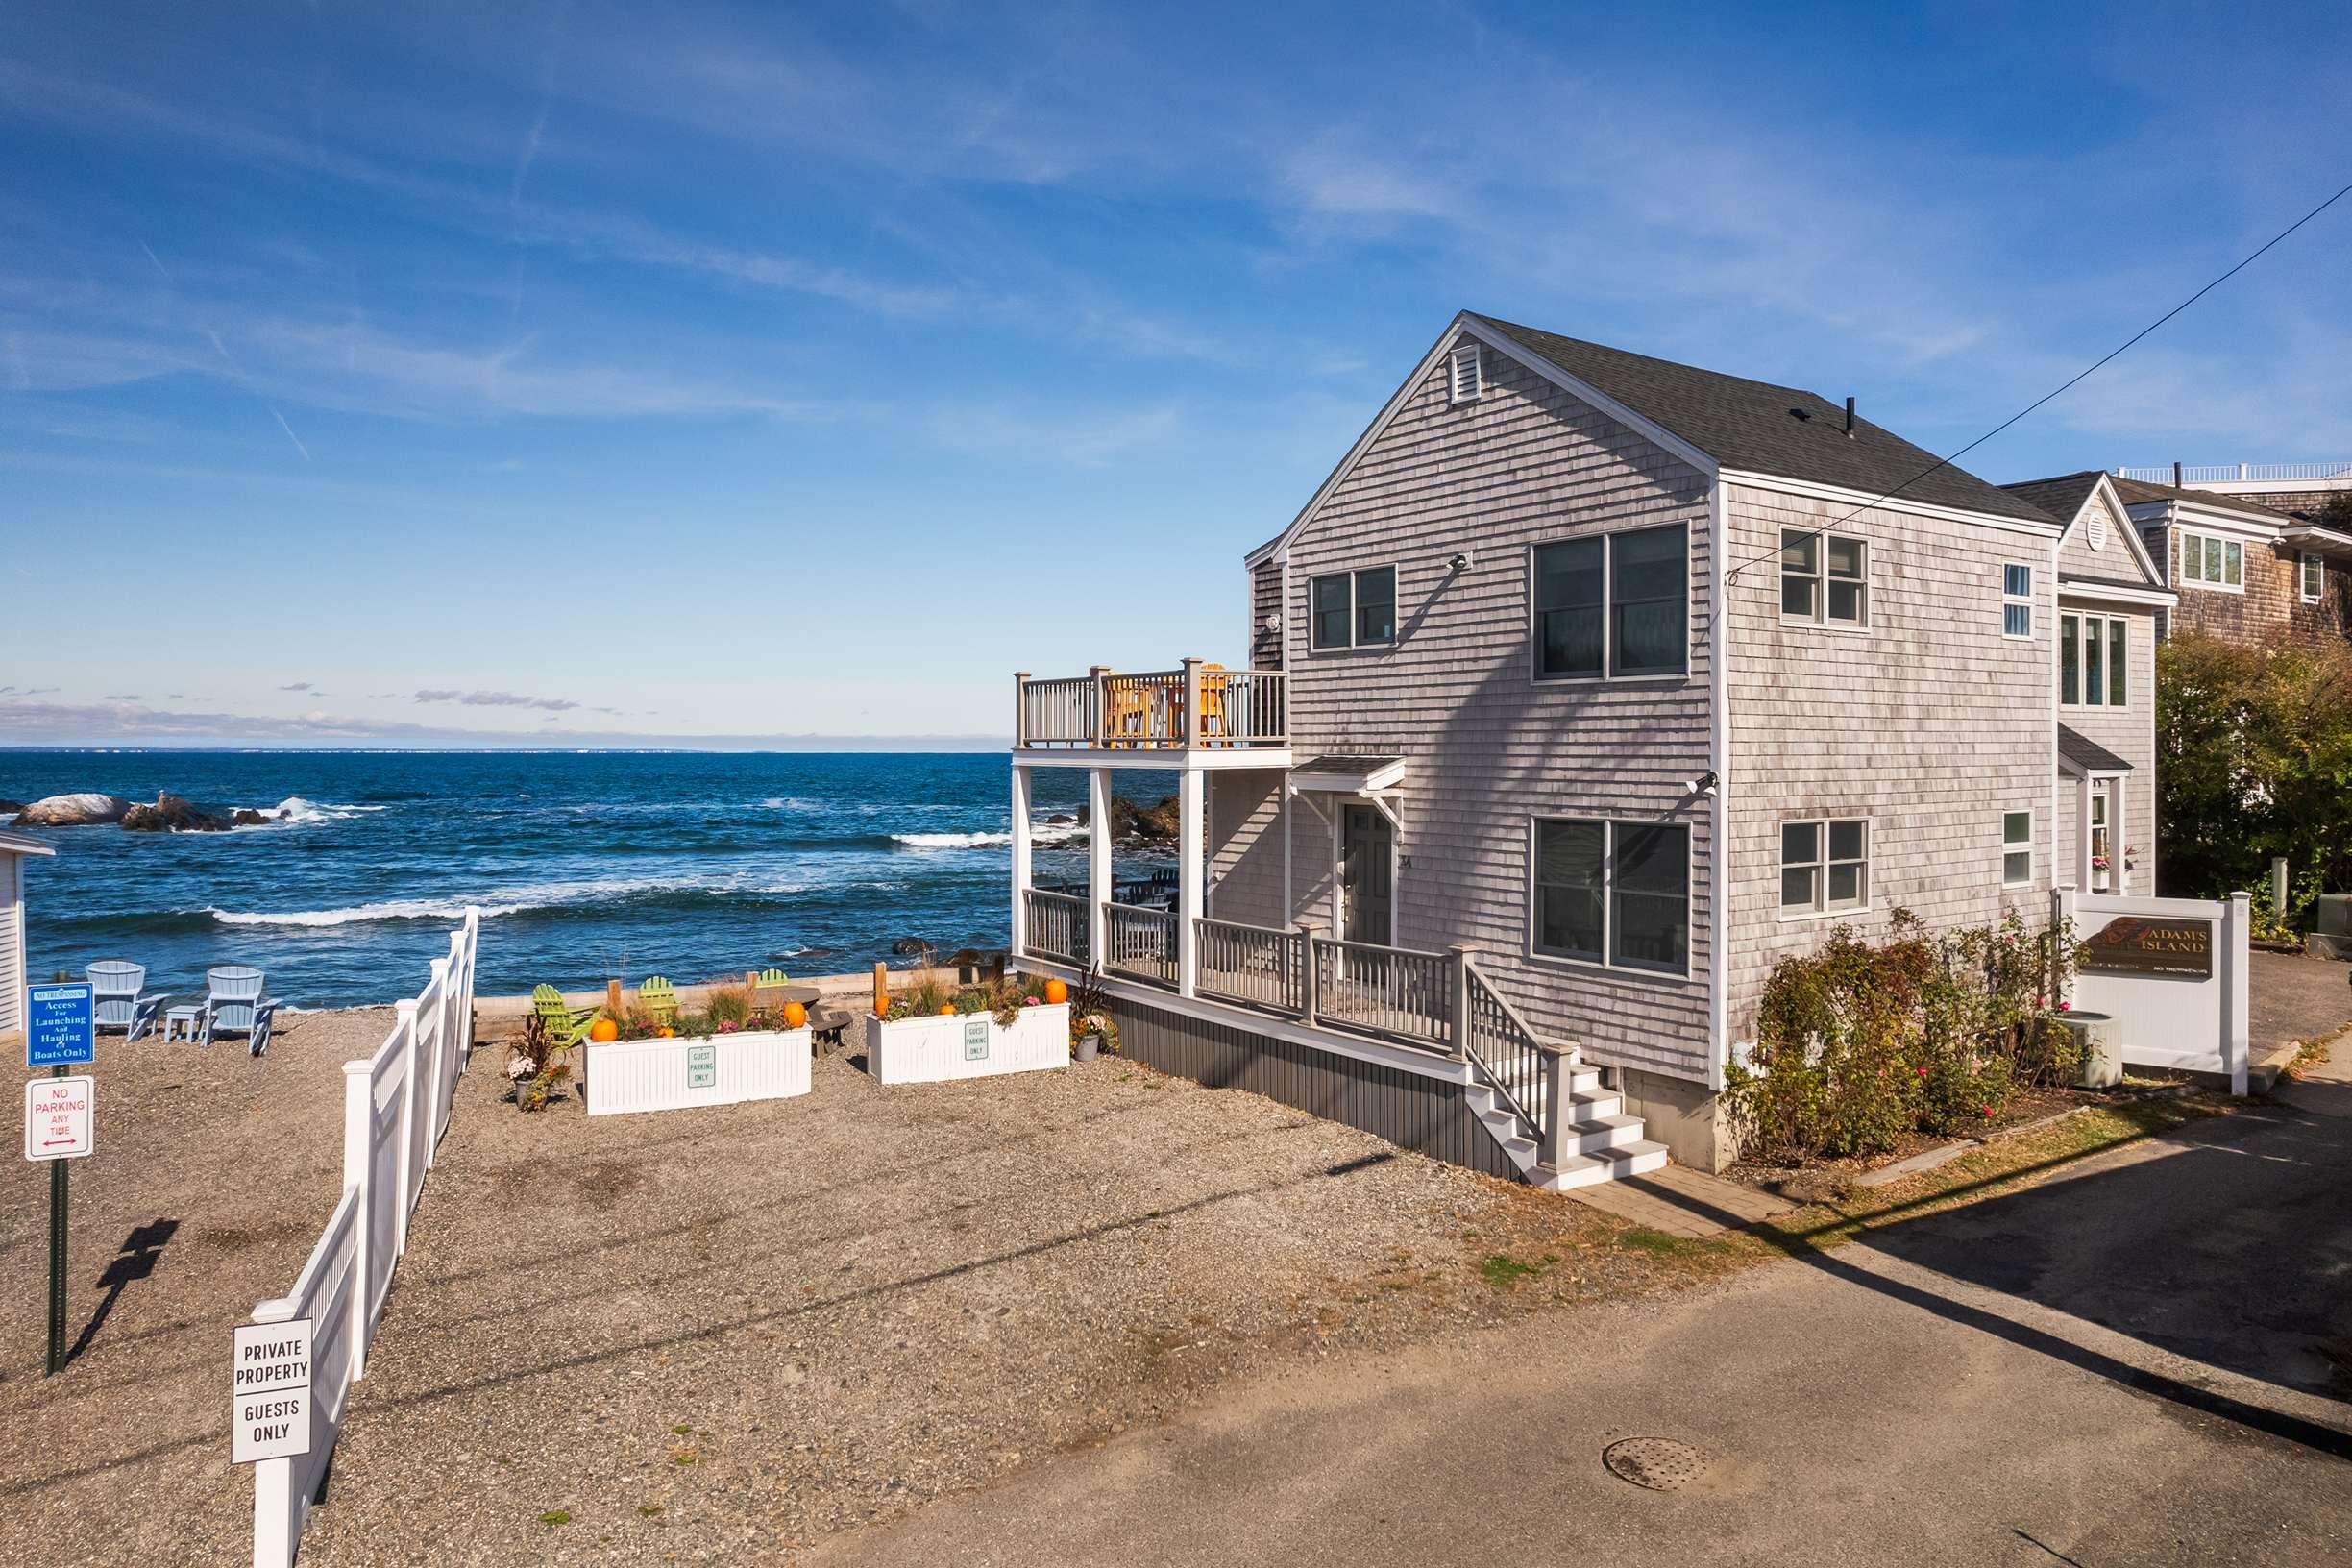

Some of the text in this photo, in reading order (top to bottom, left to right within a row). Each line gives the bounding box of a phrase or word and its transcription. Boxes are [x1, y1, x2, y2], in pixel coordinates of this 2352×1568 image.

[2142, 941, 2205, 953] ISLAND
[45, 1001, 77, 1010] Access
[36, 1016, 86, 1026] Launching
[41, 1033, 82, 1042] Hauling
[34, 1048, 86, 1060] Boats Only
[690, 1062, 714, 1071] PARKING
[694, 1073, 709, 1082] ONLY
[52, 1089, 69, 1099] NO
[35, 1100, 85, 1114] PARKING
[51, 1115, 70, 1124] ANY
[50, 1126, 70, 1136] TIME
[244, 1339, 303, 1361] PRIVATE
[236, 1361, 308, 1385] PROPERTY
[245, 1399, 300, 1422] GUESTS
[253, 1423, 290, 1443] ONLY
